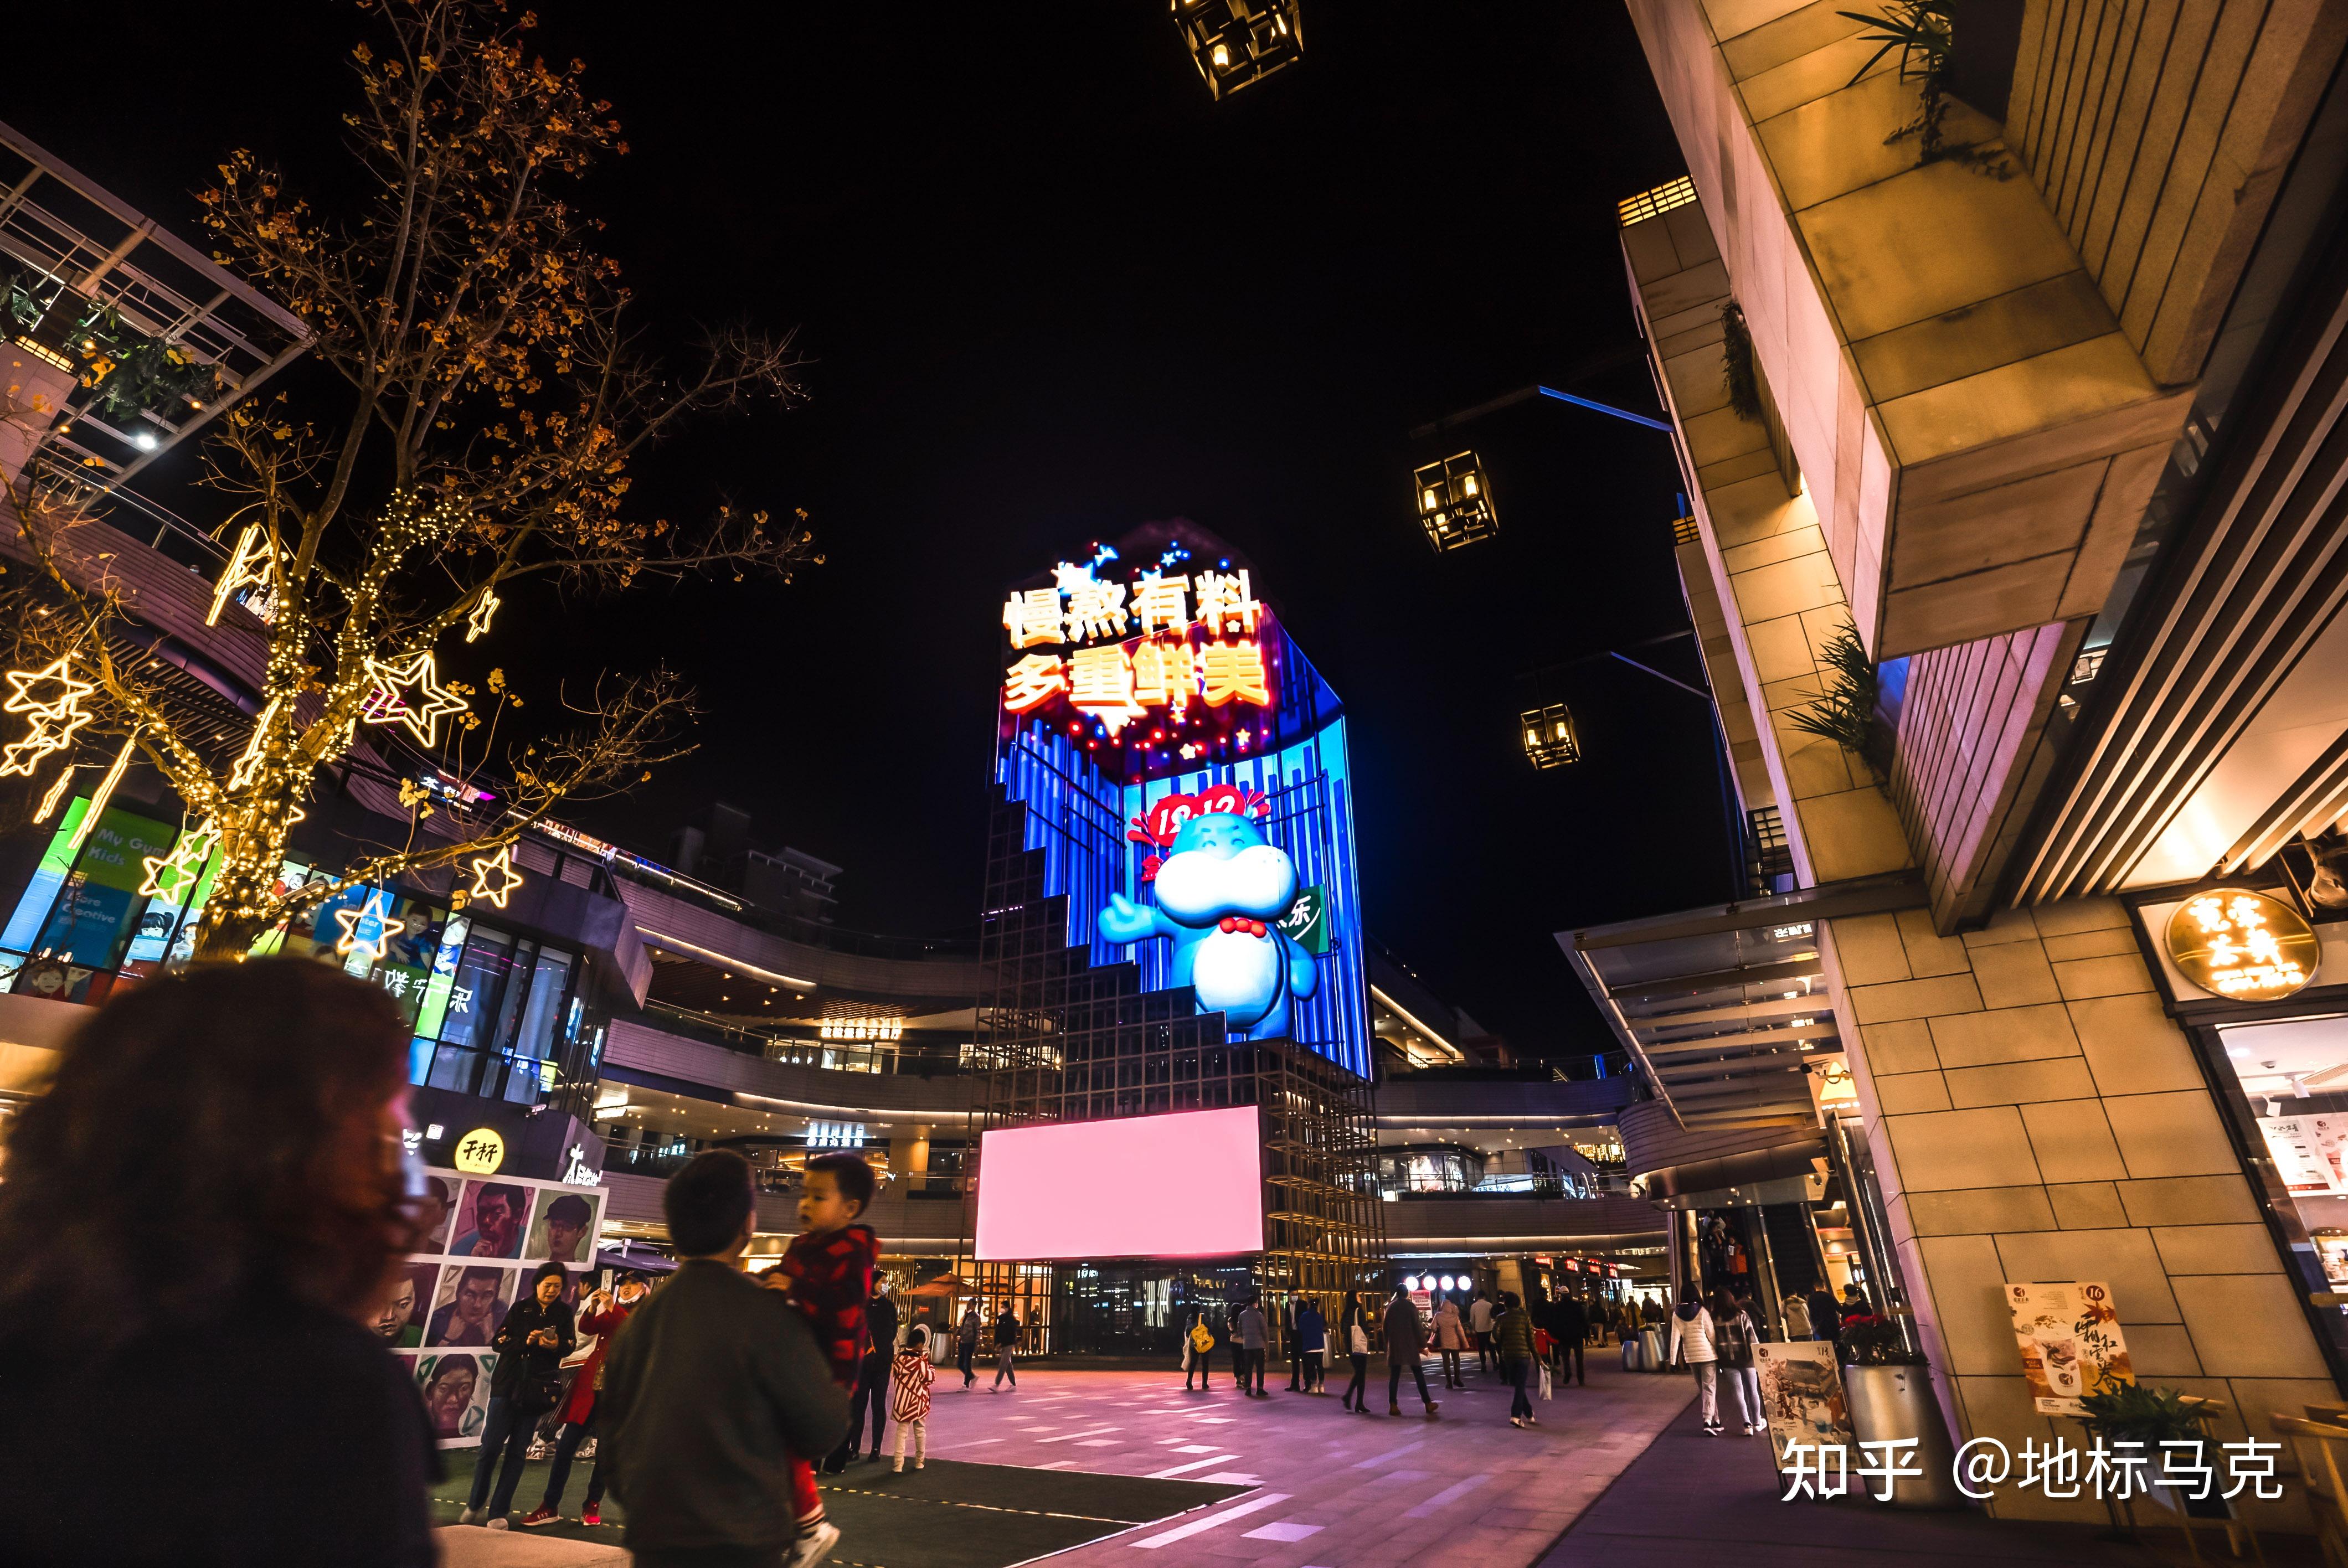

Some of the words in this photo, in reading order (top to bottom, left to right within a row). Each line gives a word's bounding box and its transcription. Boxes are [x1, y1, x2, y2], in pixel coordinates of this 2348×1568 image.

[1003, 569, 1263, 649] 慢熬有料
[1003, 640, 1269, 714] 多重鲜美
[88, 846, 125, 865] Kids
[97, 828, 123, 847] My
[129, 838, 166, 858] Gym
[1276, 895, 1311, 929] 乐
[463, 1139, 498, 1163] 干杯
[2089, 1287, 2102, 1299] 16
